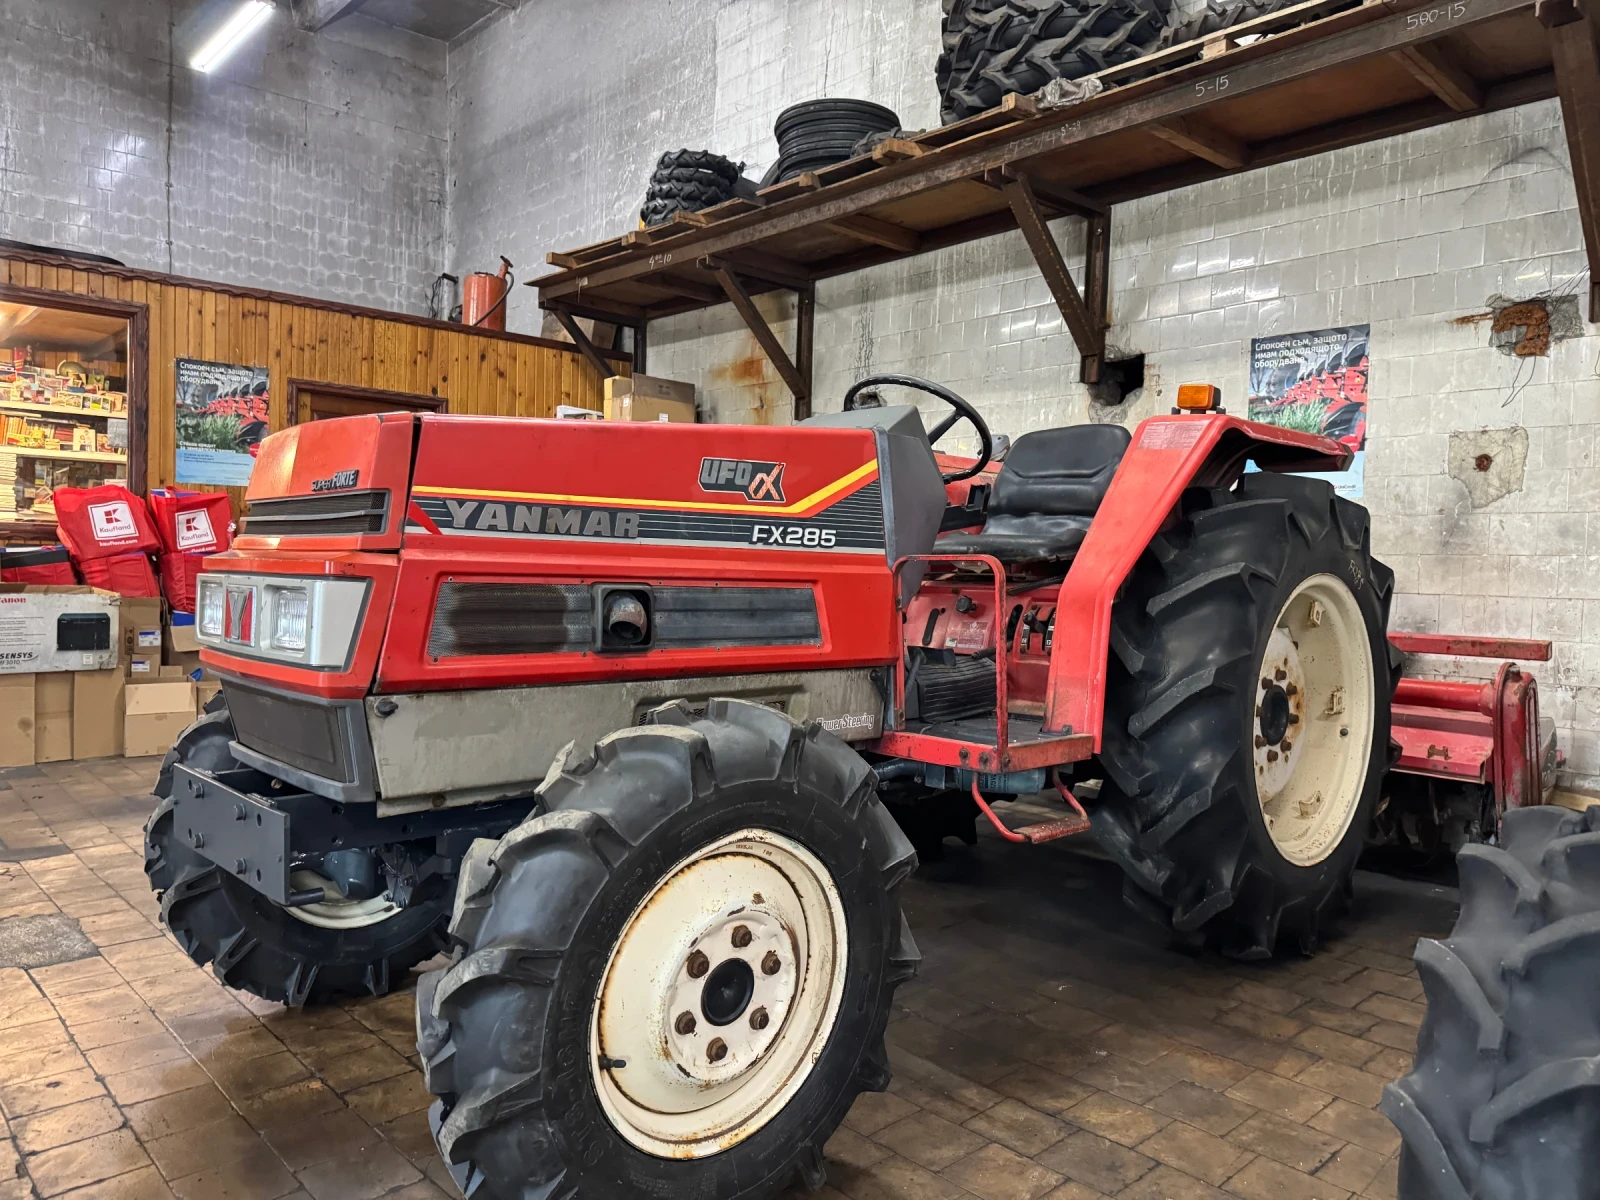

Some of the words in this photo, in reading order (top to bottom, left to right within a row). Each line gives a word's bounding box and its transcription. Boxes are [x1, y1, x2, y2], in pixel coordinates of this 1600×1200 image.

[1406, 1, 1466, 30] 500-15
[1195, 74, 1229, 97] 5-15
[1255, 341, 1291, 351] Спокоен
[1292, 338, 1312, 346] съм,
[1313, 333, 1347, 344] защото
[1255, 351, 1277, 360] имам
[1278, 343, 1340, 357] подходящото
[180, 361, 210, 372] Спокоен
[211, 367, 227, 375] съм,
[227, 368, 253, 378] защото
[1254, 356, 1305, 369] оборудване
[180, 369, 199, 377] имам
[200, 371, 249, 382] подходящото
[332, 469, 357, 488] FORTE
[700, 459, 752, 486] UFO
[445, 499, 641, 538] YANMAR
[99, 524, 132, 534] Kaufland
[180, 531, 209, 541] Kaufland
[752, 525, 837, 547] FX285
[99, 538, 138, 547] kaufland.com
[842, 712, 875, 730] Steering
